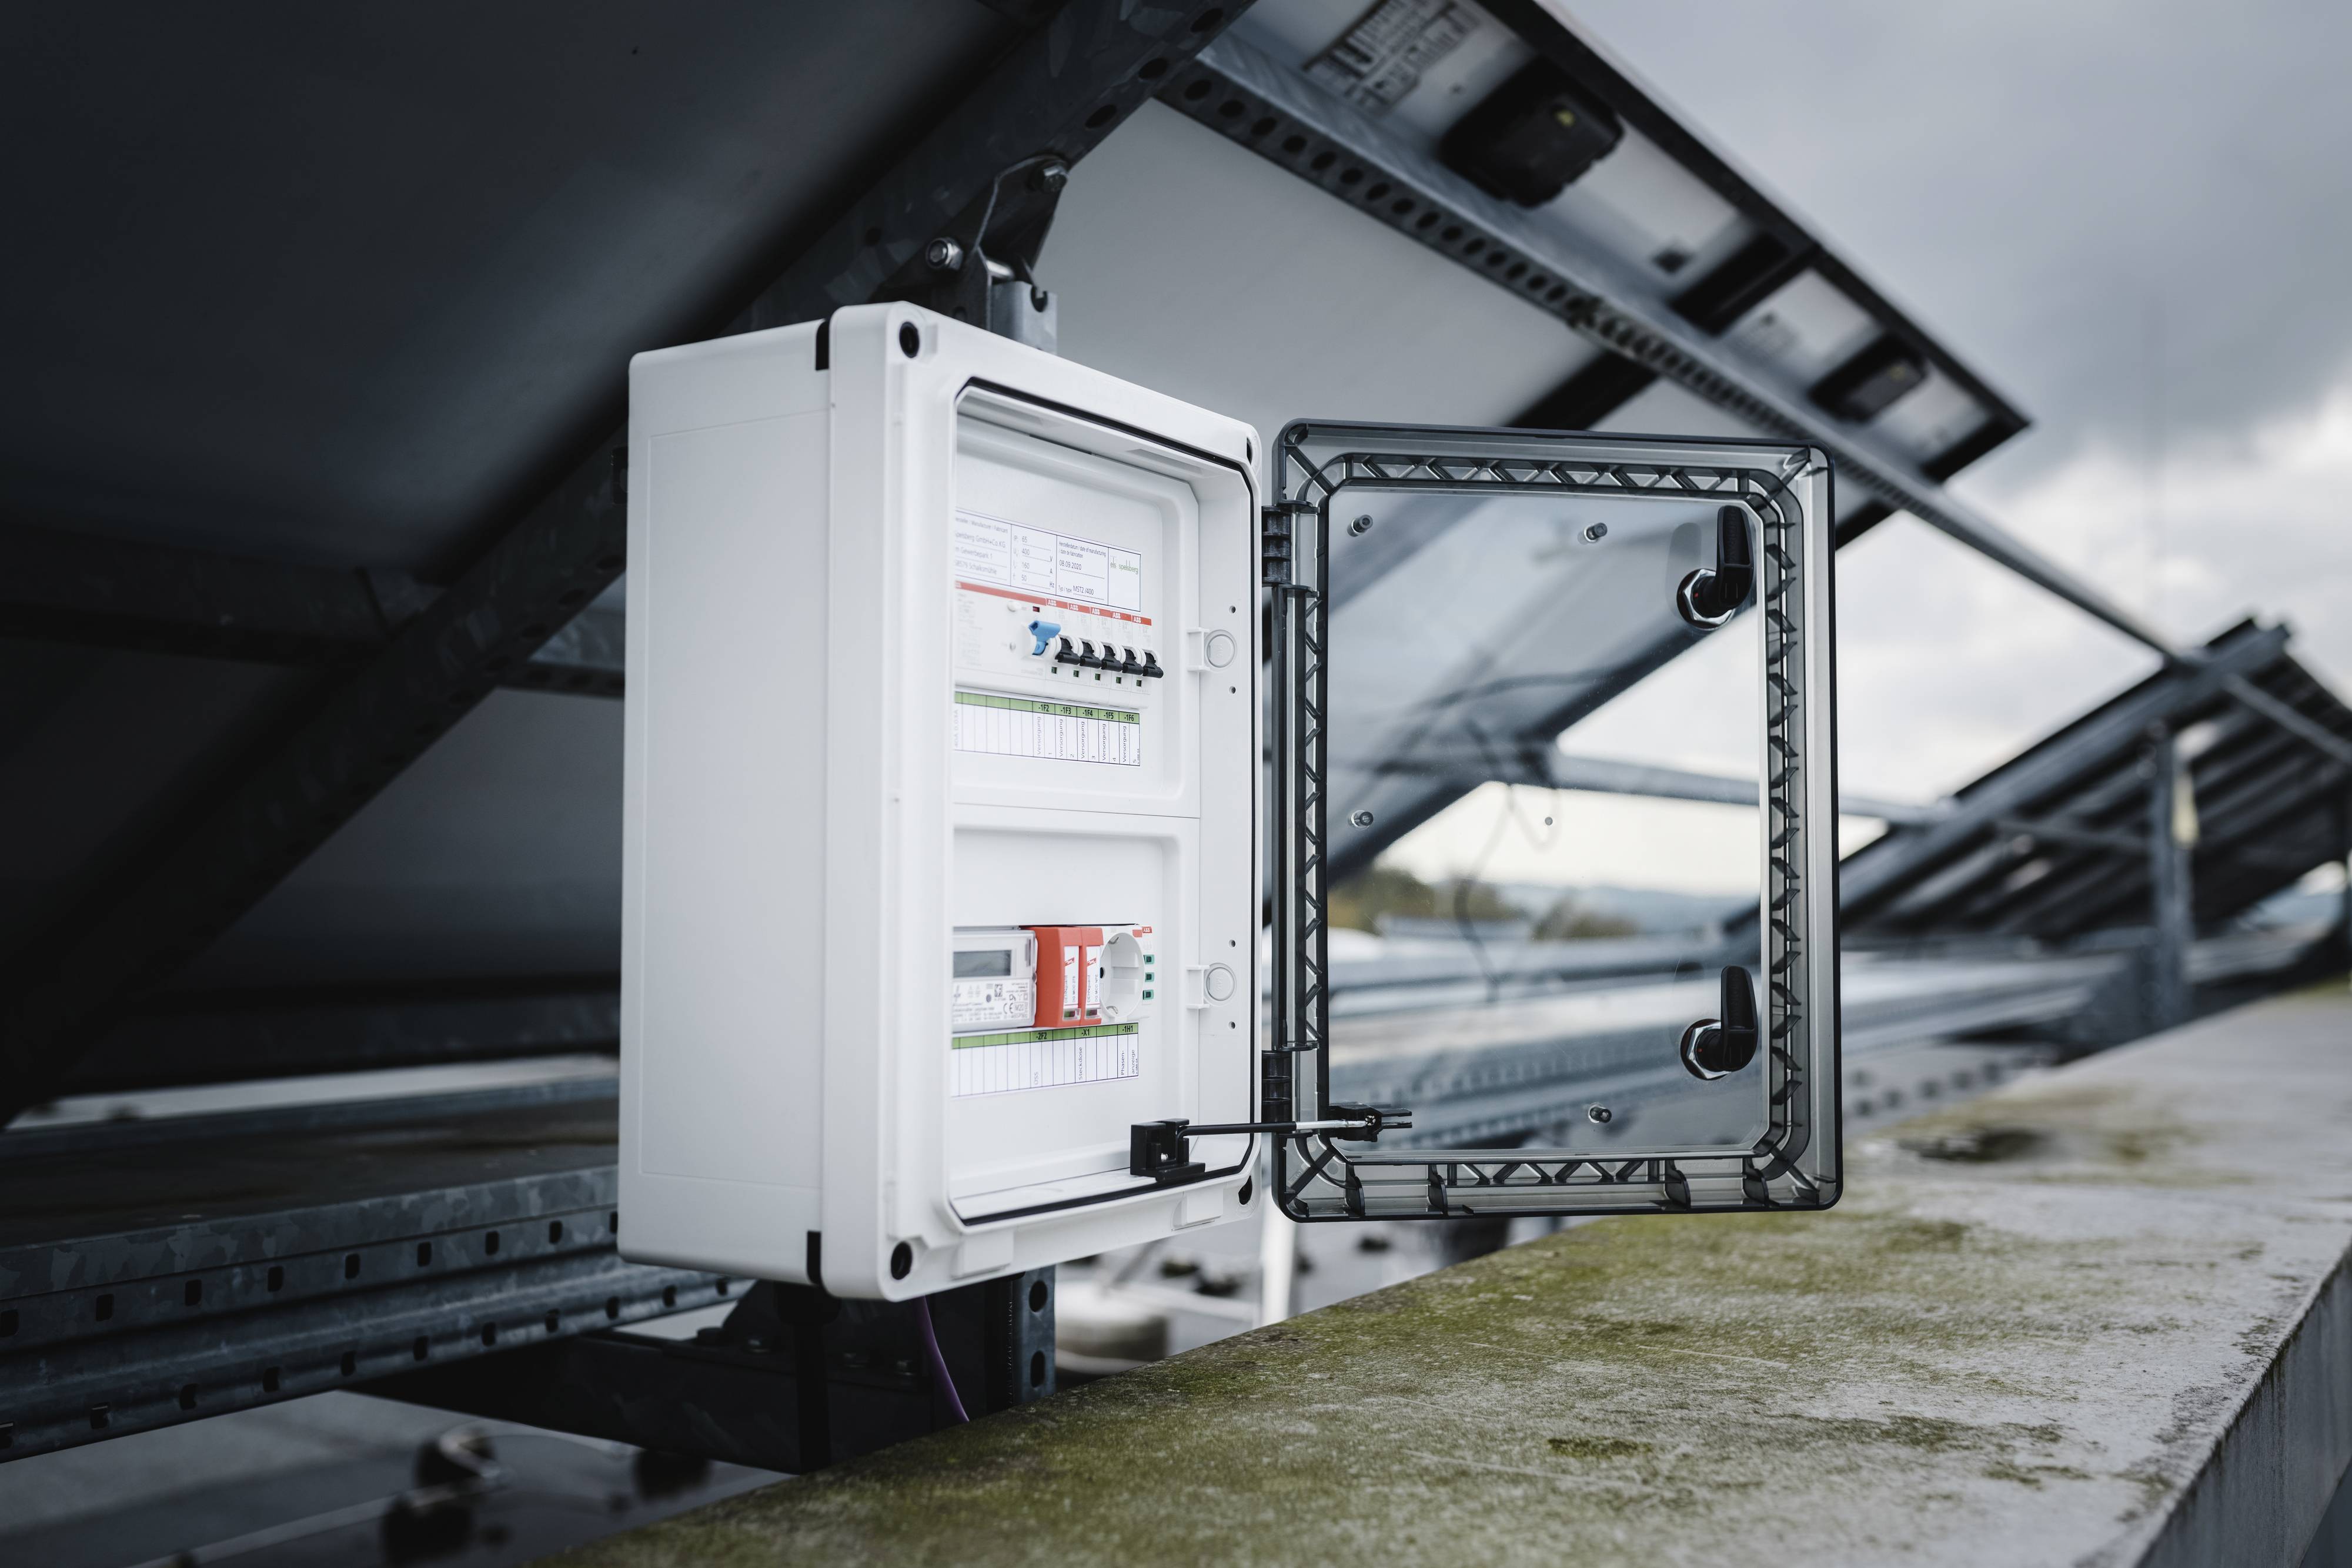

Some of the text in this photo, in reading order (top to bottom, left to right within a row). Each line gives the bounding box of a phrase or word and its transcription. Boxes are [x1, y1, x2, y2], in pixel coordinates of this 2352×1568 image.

[1059, 559, 1082, 570] 08.09.2020
[1118, 559, 1138, 575] spelsberg
[1021, 574, 1027, 582] 50
[1073, 585, 1084, 594] MST2
[1061, 707, 1071, 715] -1F3
[1083, 709, 1093, 717] -1F4
